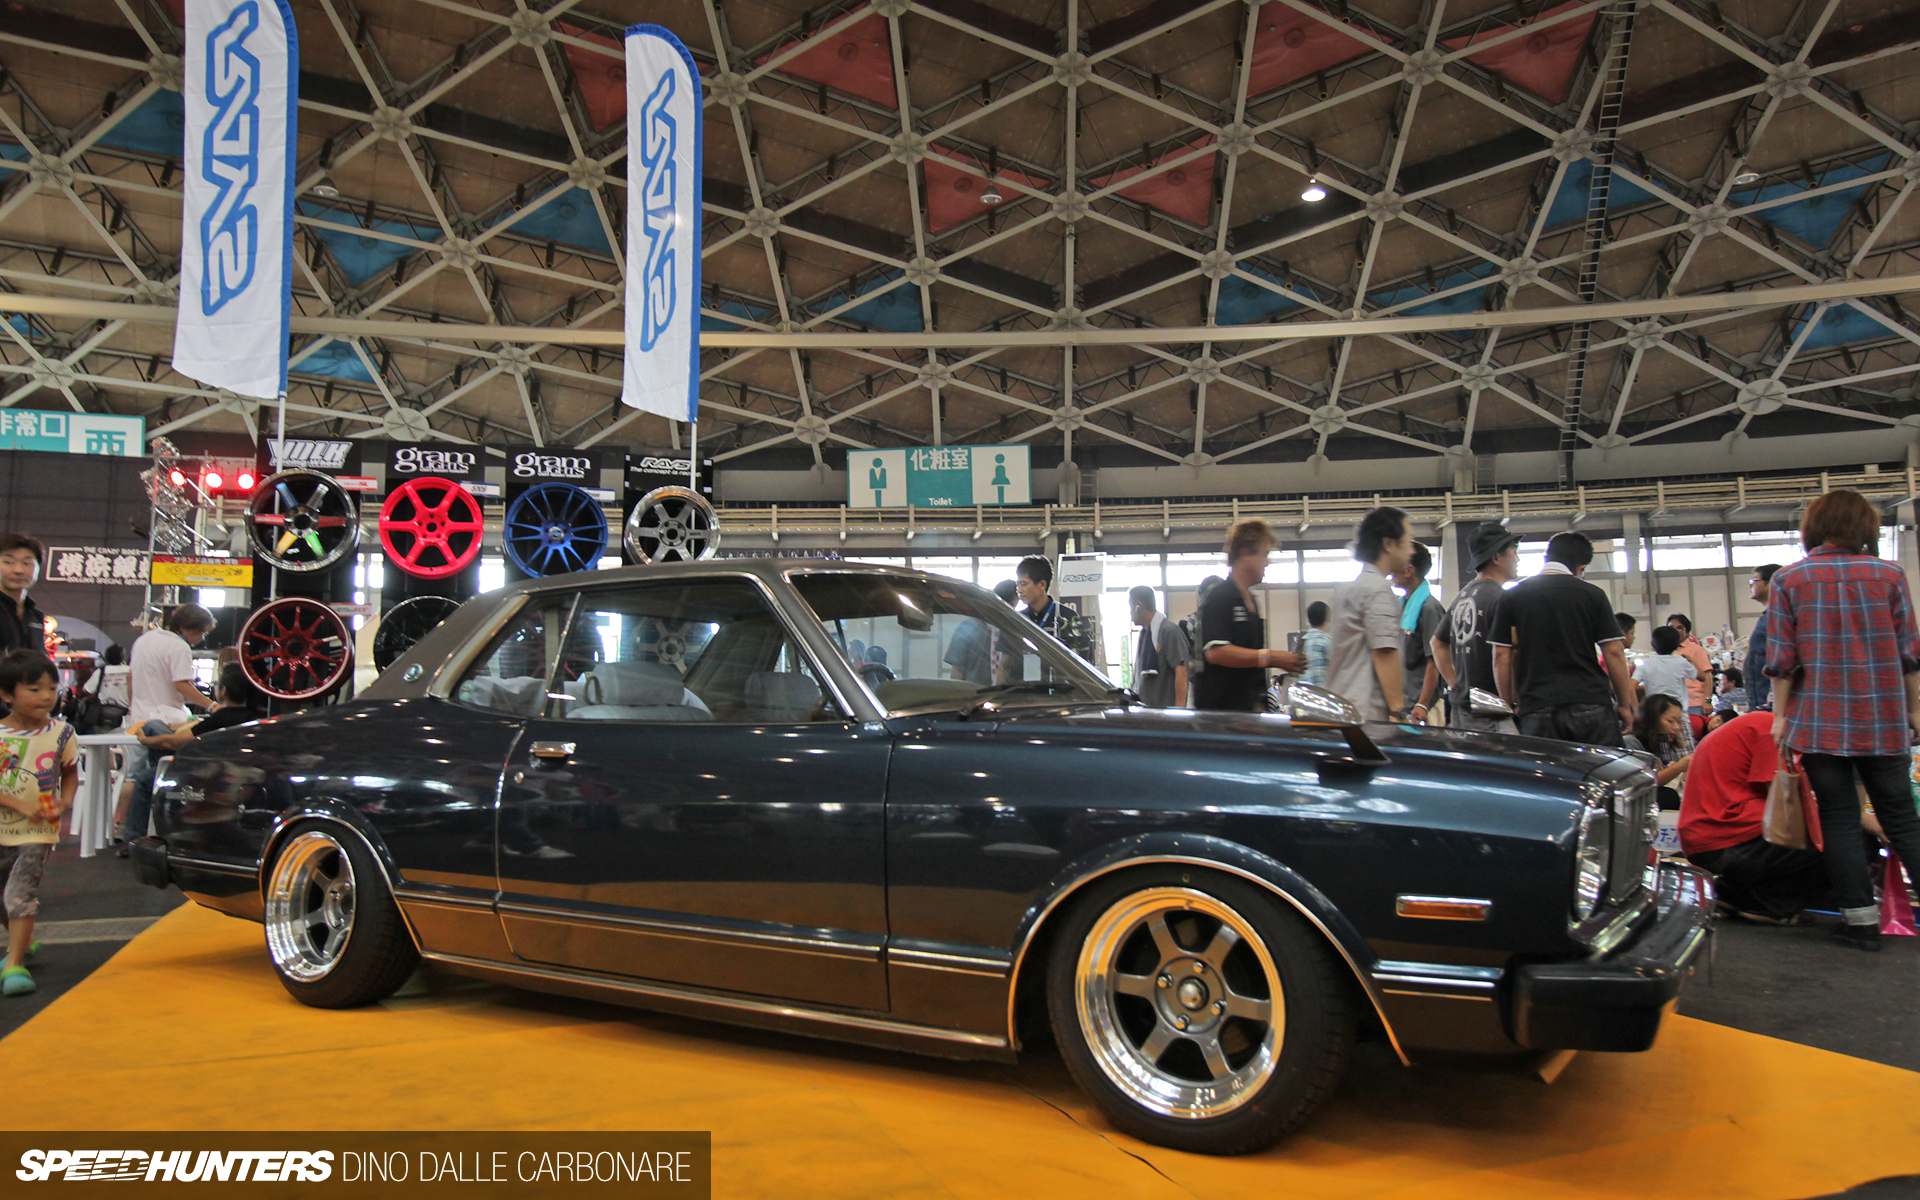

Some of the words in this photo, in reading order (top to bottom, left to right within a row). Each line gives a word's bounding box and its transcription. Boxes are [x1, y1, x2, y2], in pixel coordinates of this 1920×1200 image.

[201, 0, 260, 316] RAYS
[640, 68, 676, 352] RAYS
[394, 447, 476, 473] gram
[513, 452, 591, 477] gram
[640, 456, 692, 470] RAYS
[909, 447, 969, 471] 化粧室
[928, 497, 953, 506] Toilet
[1062, 573, 1102, 582] RAYS
